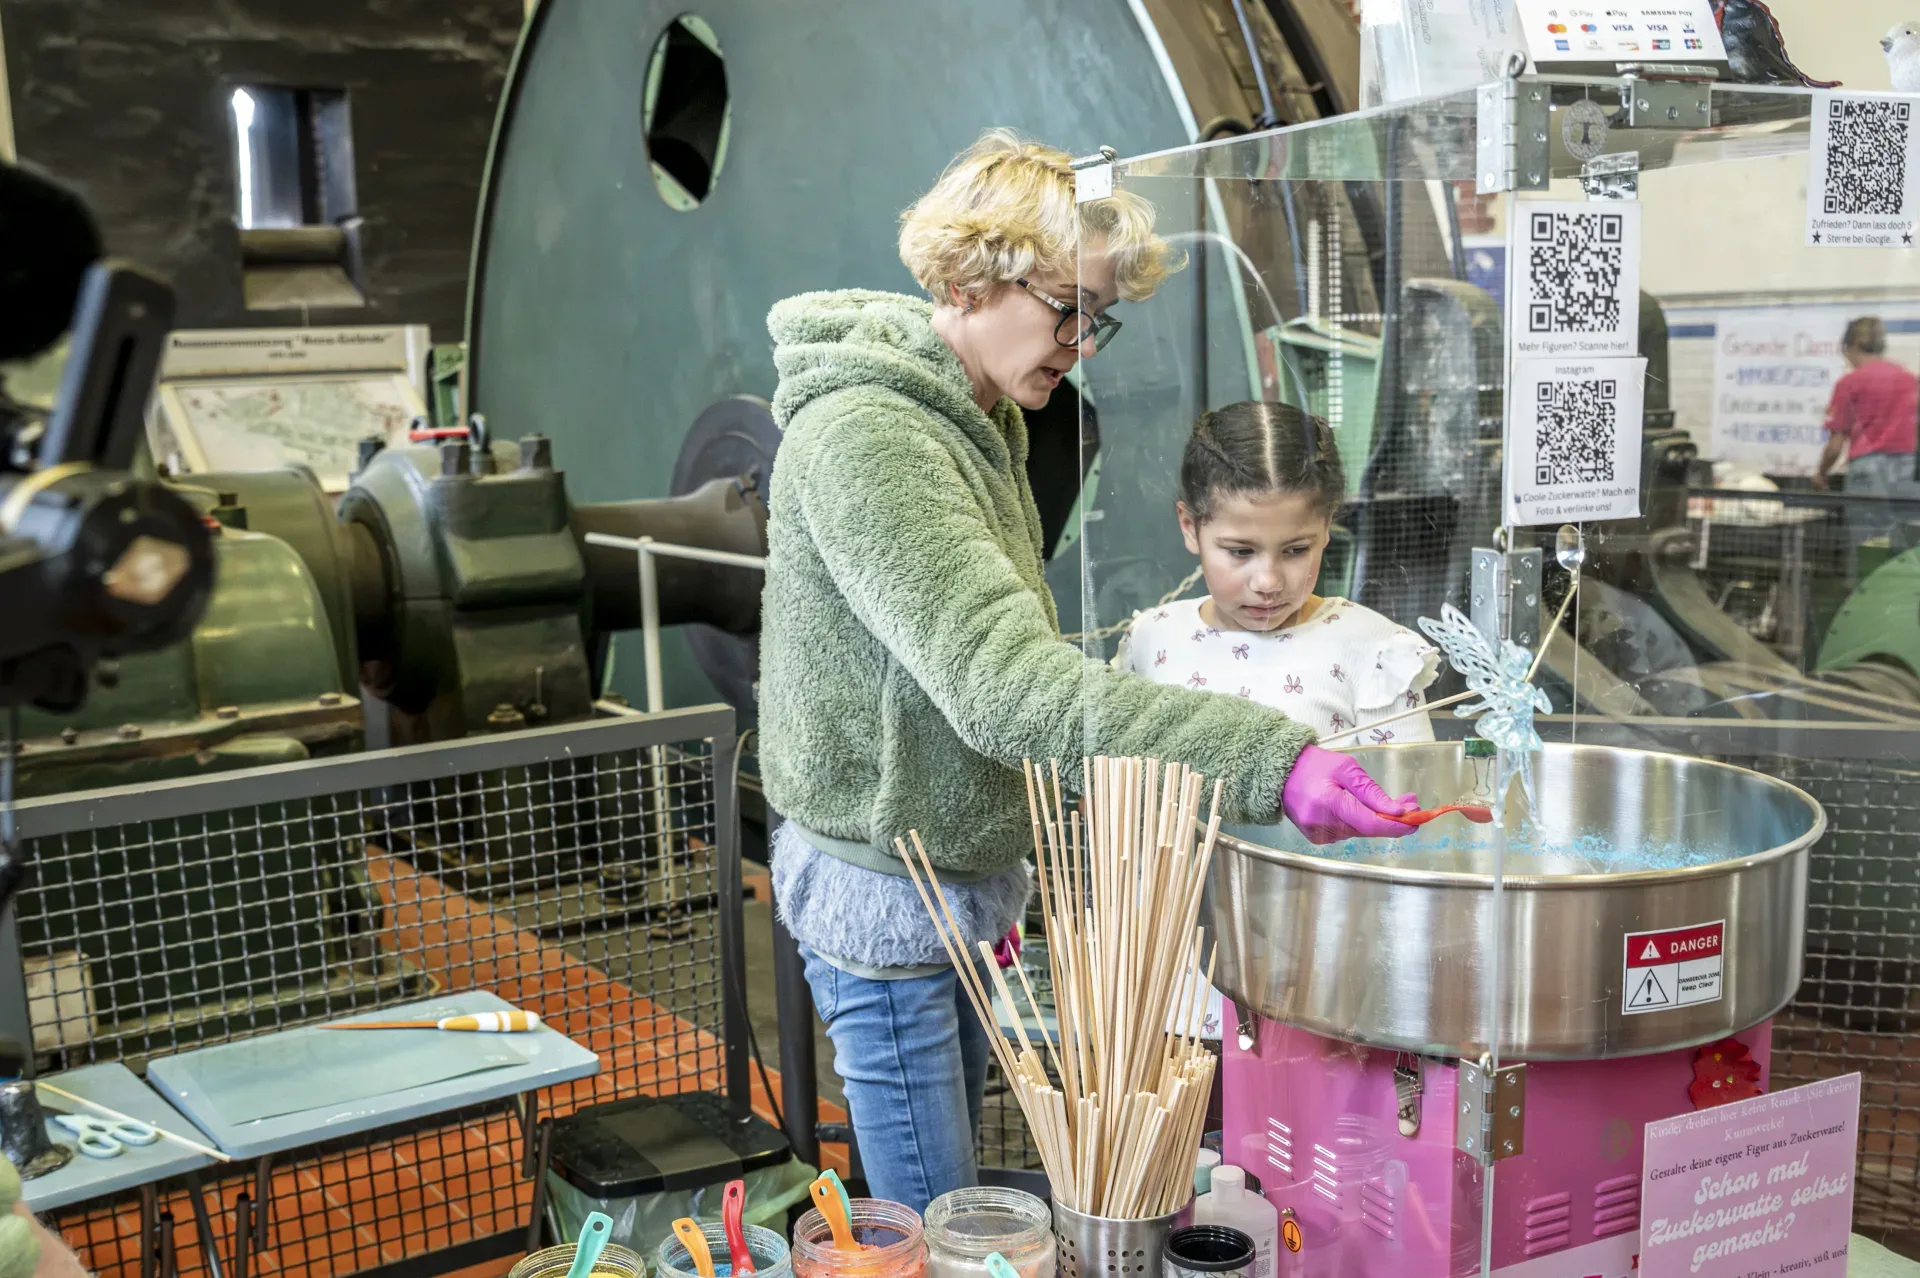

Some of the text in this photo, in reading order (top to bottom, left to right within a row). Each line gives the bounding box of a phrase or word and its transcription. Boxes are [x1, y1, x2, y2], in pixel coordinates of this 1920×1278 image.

[1579, 10, 1593, 18] Pay
[1612, 10, 1628, 18] Pay
[1812, 219, 1912, 230] Zufrieden? Dann lass doch 5
[1827, 234, 1896, 245] Sterne bei Google...
[1519, 341, 1629, 353] Mehr Figuren? Scanne hier!
[1555, 366, 1594, 376] Instagram
[1523, 487, 1636, 502] Coole Zuckerwatte? Mach ein
[1536, 502, 1612, 515] Foto & verlinke uns!
[1671, 935, 1718, 954] DANGER
[1650, 1122, 1681, 1139] Kinder
[1686, 1114, 1717, 1130] drehen
[1720, 1111, 1737, 1121] hier
[1742, 1101, 1767, 1116] keine
[1809, 1087, 1822, 1099] Sie
[1826, 1081, 1855, 1095] drehen
[1725, 1116, 1785, 1141] Kunstwerke!
[1650, 1120, 1845, 1180] Gestalte deine eigene Figur aus Zuckerwatte!
[1694, 1150, 1810, 1205] Schon mal
[1648, 1172, 1848, 1247] Zuckerwatte selbst
[1690, 1212, 1796, 1273] gemacht?
[1780, 1258, 1811, 1274] kreativ,
[1832, 1244, 1848, 1259] und
